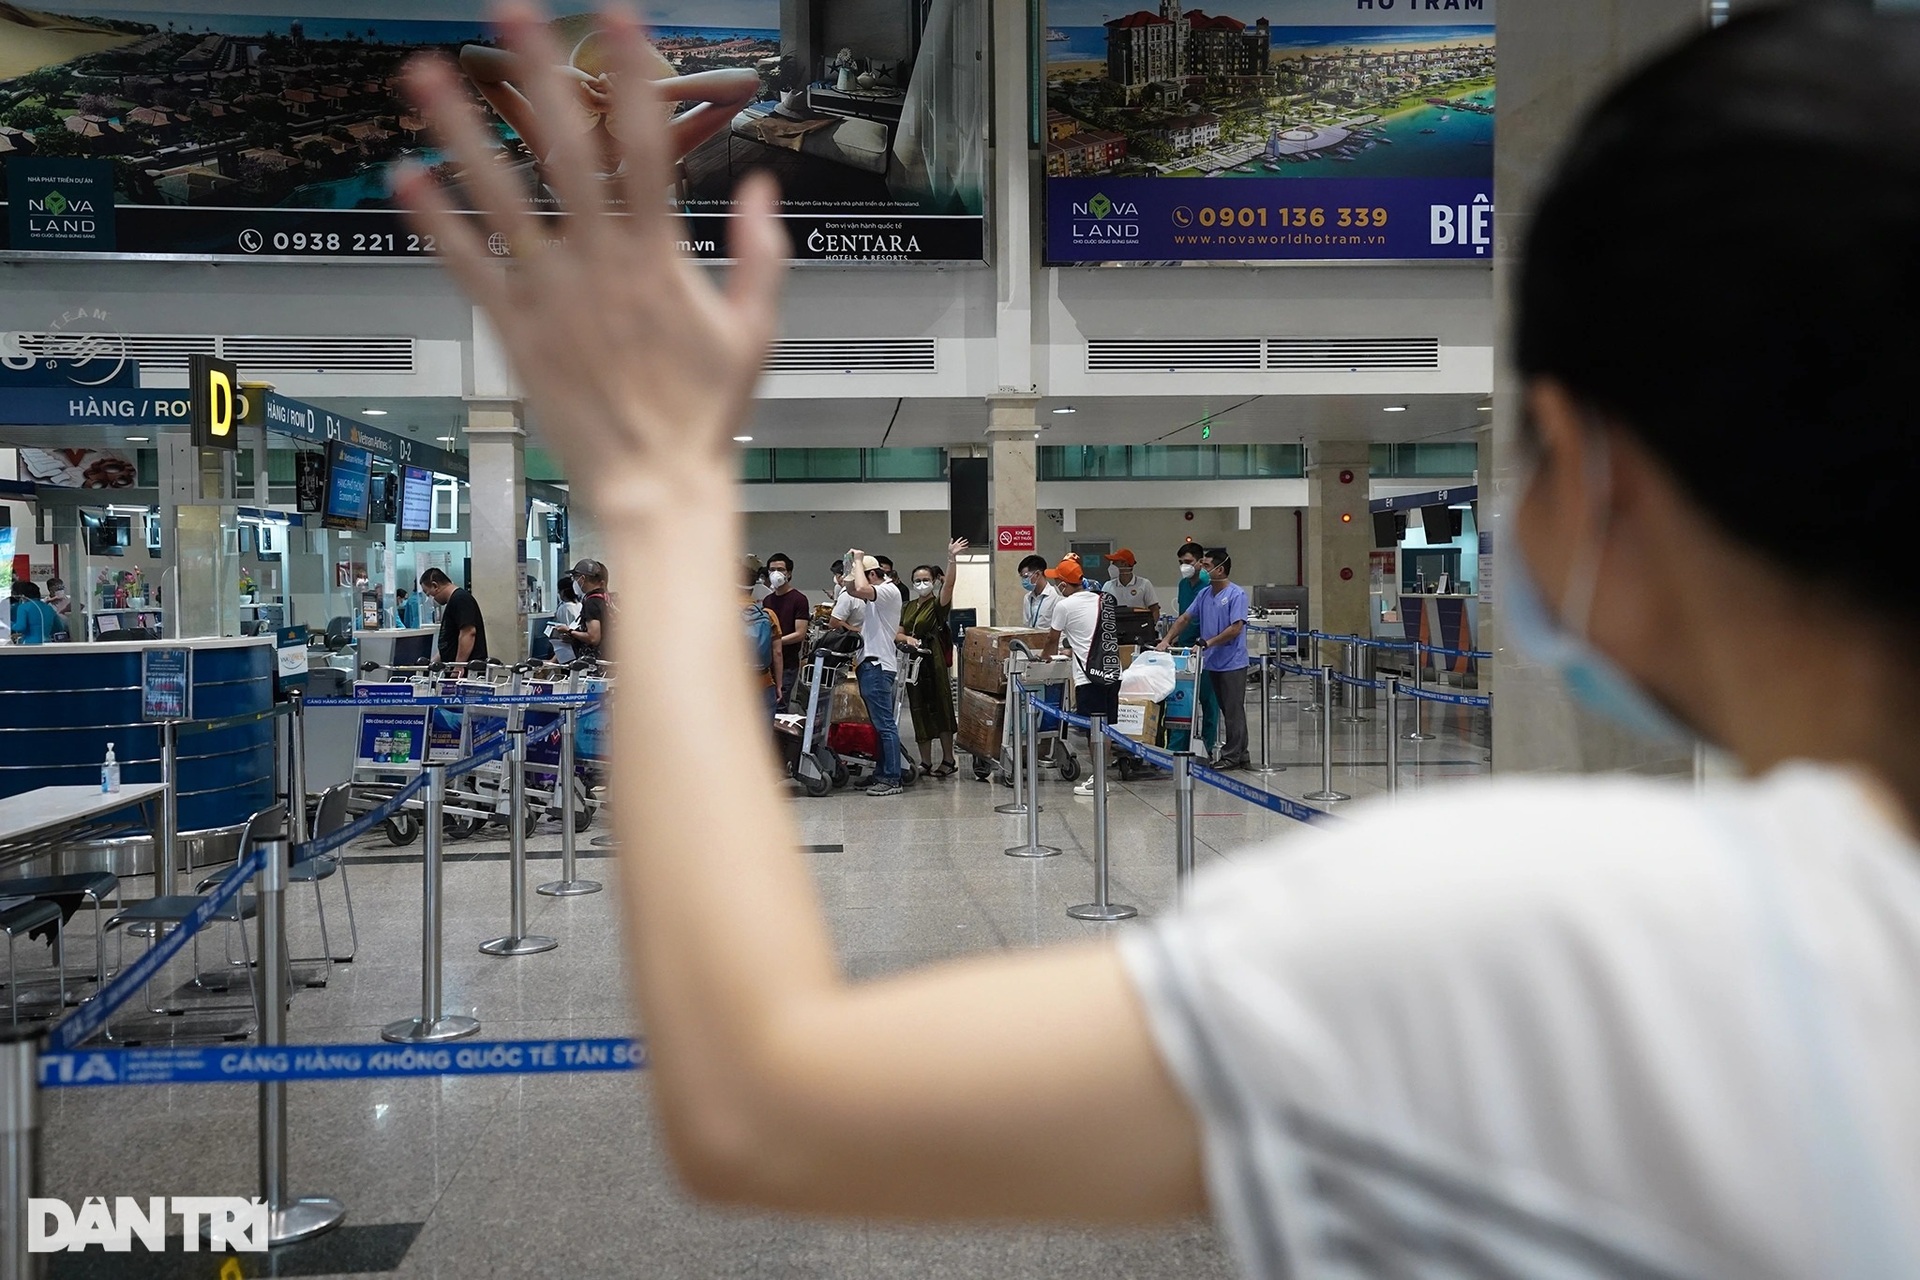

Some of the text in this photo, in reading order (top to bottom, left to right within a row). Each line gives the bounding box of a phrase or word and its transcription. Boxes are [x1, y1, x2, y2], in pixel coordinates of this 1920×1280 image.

[29, 194, 94, 213] NOVA
[1073, 198, 1138, 216] NOVA
[29, 219, 96, 232] LAND
[1199, 207, 1388, 227] 0901 136 339
[1430, 194, 1494, 254] BIỆ
[808, 229, 922, 252] CENTARA
[1073, 224, 1139, 237] LAND
[1174, 234, 1386, 244] www.novaworldhotram.vn
[273, 232, 440, 252] 0938 221 22
[69, 396, 135, 417] HÀNG
[140, 400, 148, 417] /
[155, 400, 191, 417] RO
[210, 370, 232, 436] D
[266, 400, 286, 423] HÀNG
[290, 409, 306, 428] ROW
[307, 409, 315, 434] D
[326, 416, 341, 440] D-1
[400, 440, 412, 462] D-2
[1279, 799, 1294, 816] TIA
[294, 1047, 361, 1072] HÀNG
[368, 1044, 450, 1072] KHÔNG
[530, 1040, 558, 1067] TẾ
